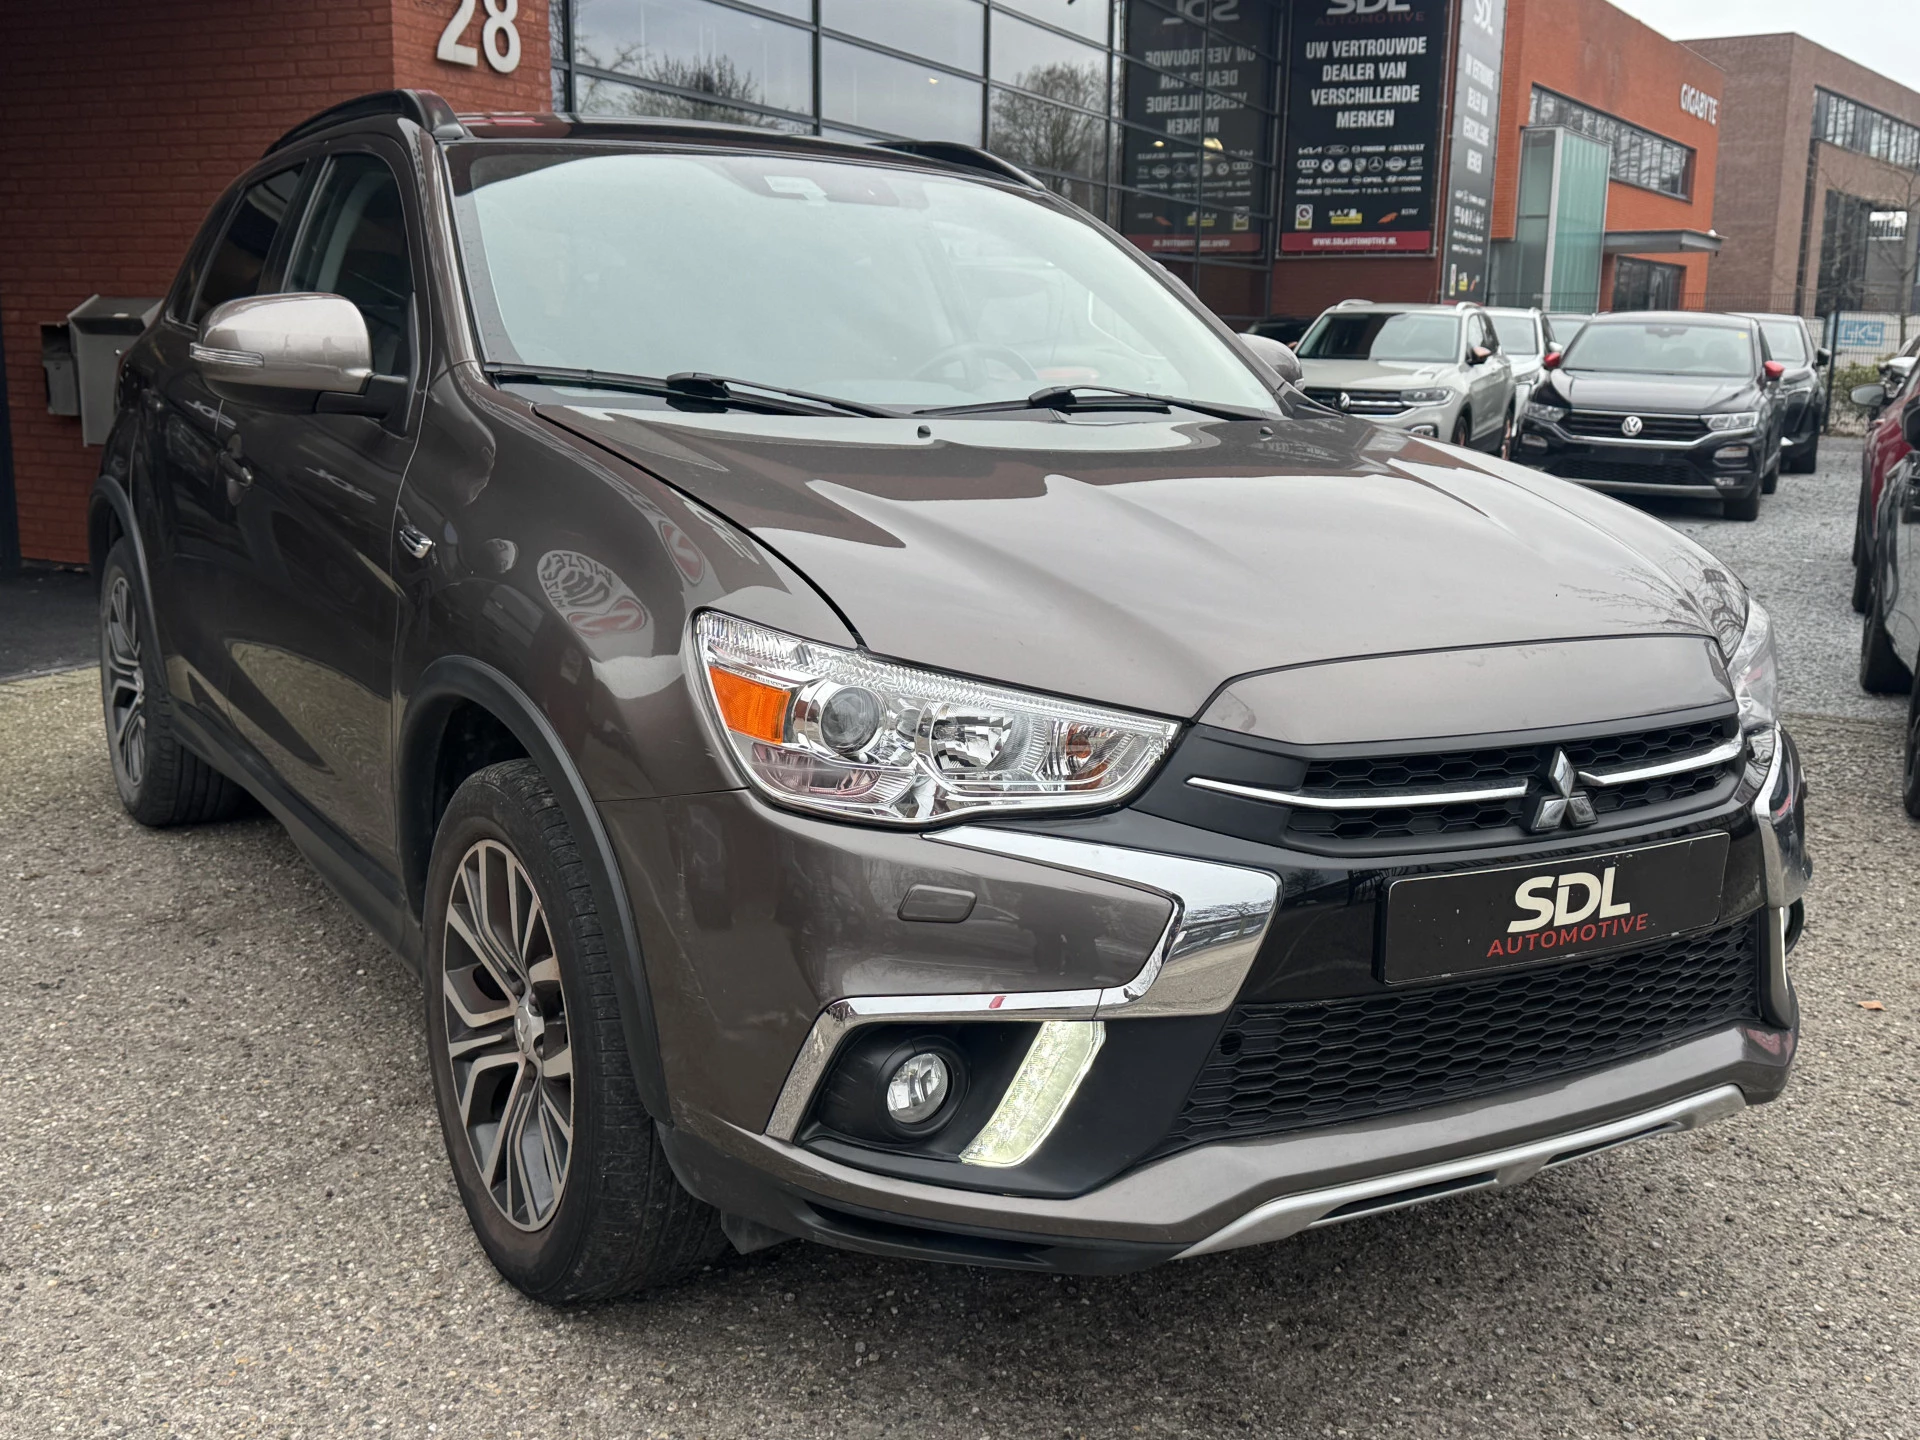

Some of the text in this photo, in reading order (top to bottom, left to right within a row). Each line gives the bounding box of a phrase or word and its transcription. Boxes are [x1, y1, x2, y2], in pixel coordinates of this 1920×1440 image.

[1315, 11, 1425, 26] AUTOMOTIVE
[437, 0, 521, 74] 28
[1306, 36, 1427, 59] UW VERTROUWDE
[1322, 61, 1407, 82] DEALER VAN
[1311, 84, 1420, 106] VERSCHILLENDE
[1680, 82, 1718, 126] GIGABYTE
[1336, 109, 1395, 128] MERKEN
[1507, 866, 1631, 933] SDL
[1486, 912, 1649, 957] AUTOMOTIVE
